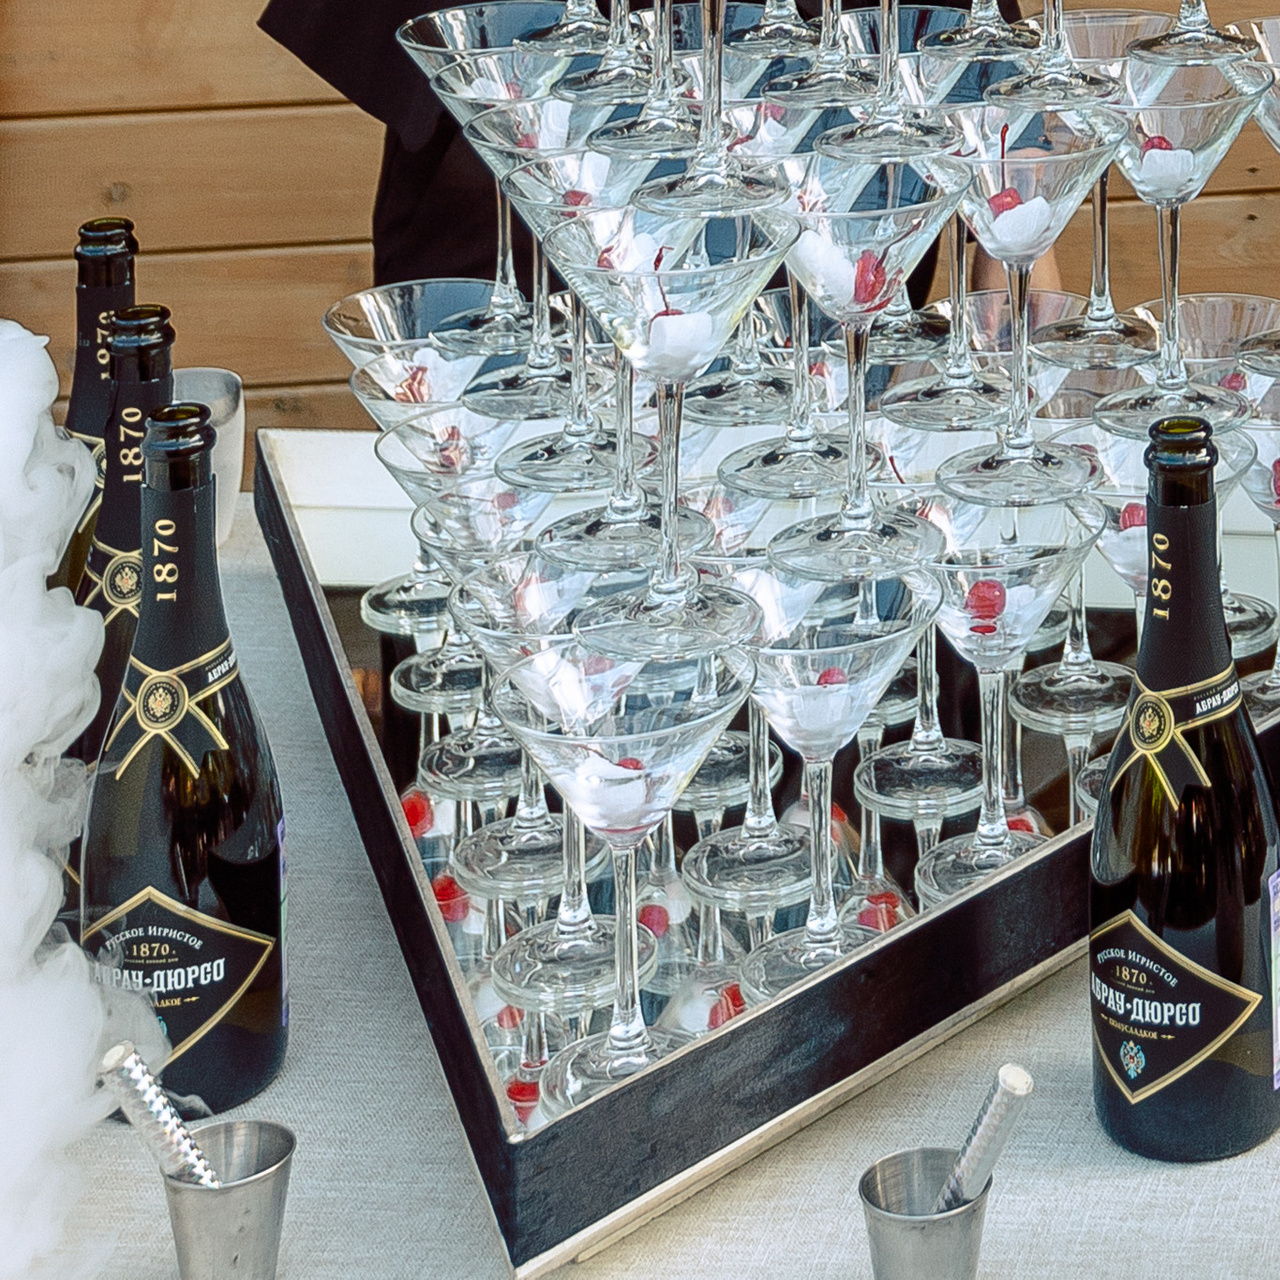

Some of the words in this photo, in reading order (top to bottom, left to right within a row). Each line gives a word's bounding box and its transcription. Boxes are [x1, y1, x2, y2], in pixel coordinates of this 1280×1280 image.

[120, 407, 144, 482] 1870
[153, 518, 179, 602] 1870
[1151, 532, 1172, 621] 1870
[105, 927, 145, 951] РУССКОЕ
[148, 925, 204, 950] ИГРИСТОЕ
[132, 942, 170, 957] 1870
[1097, 948, 1126, 964] РУССКОЕ
[1128, 950, 1178, 988] ИГРИСТОЕ
[1116, 965, 1147, 984] 1870
